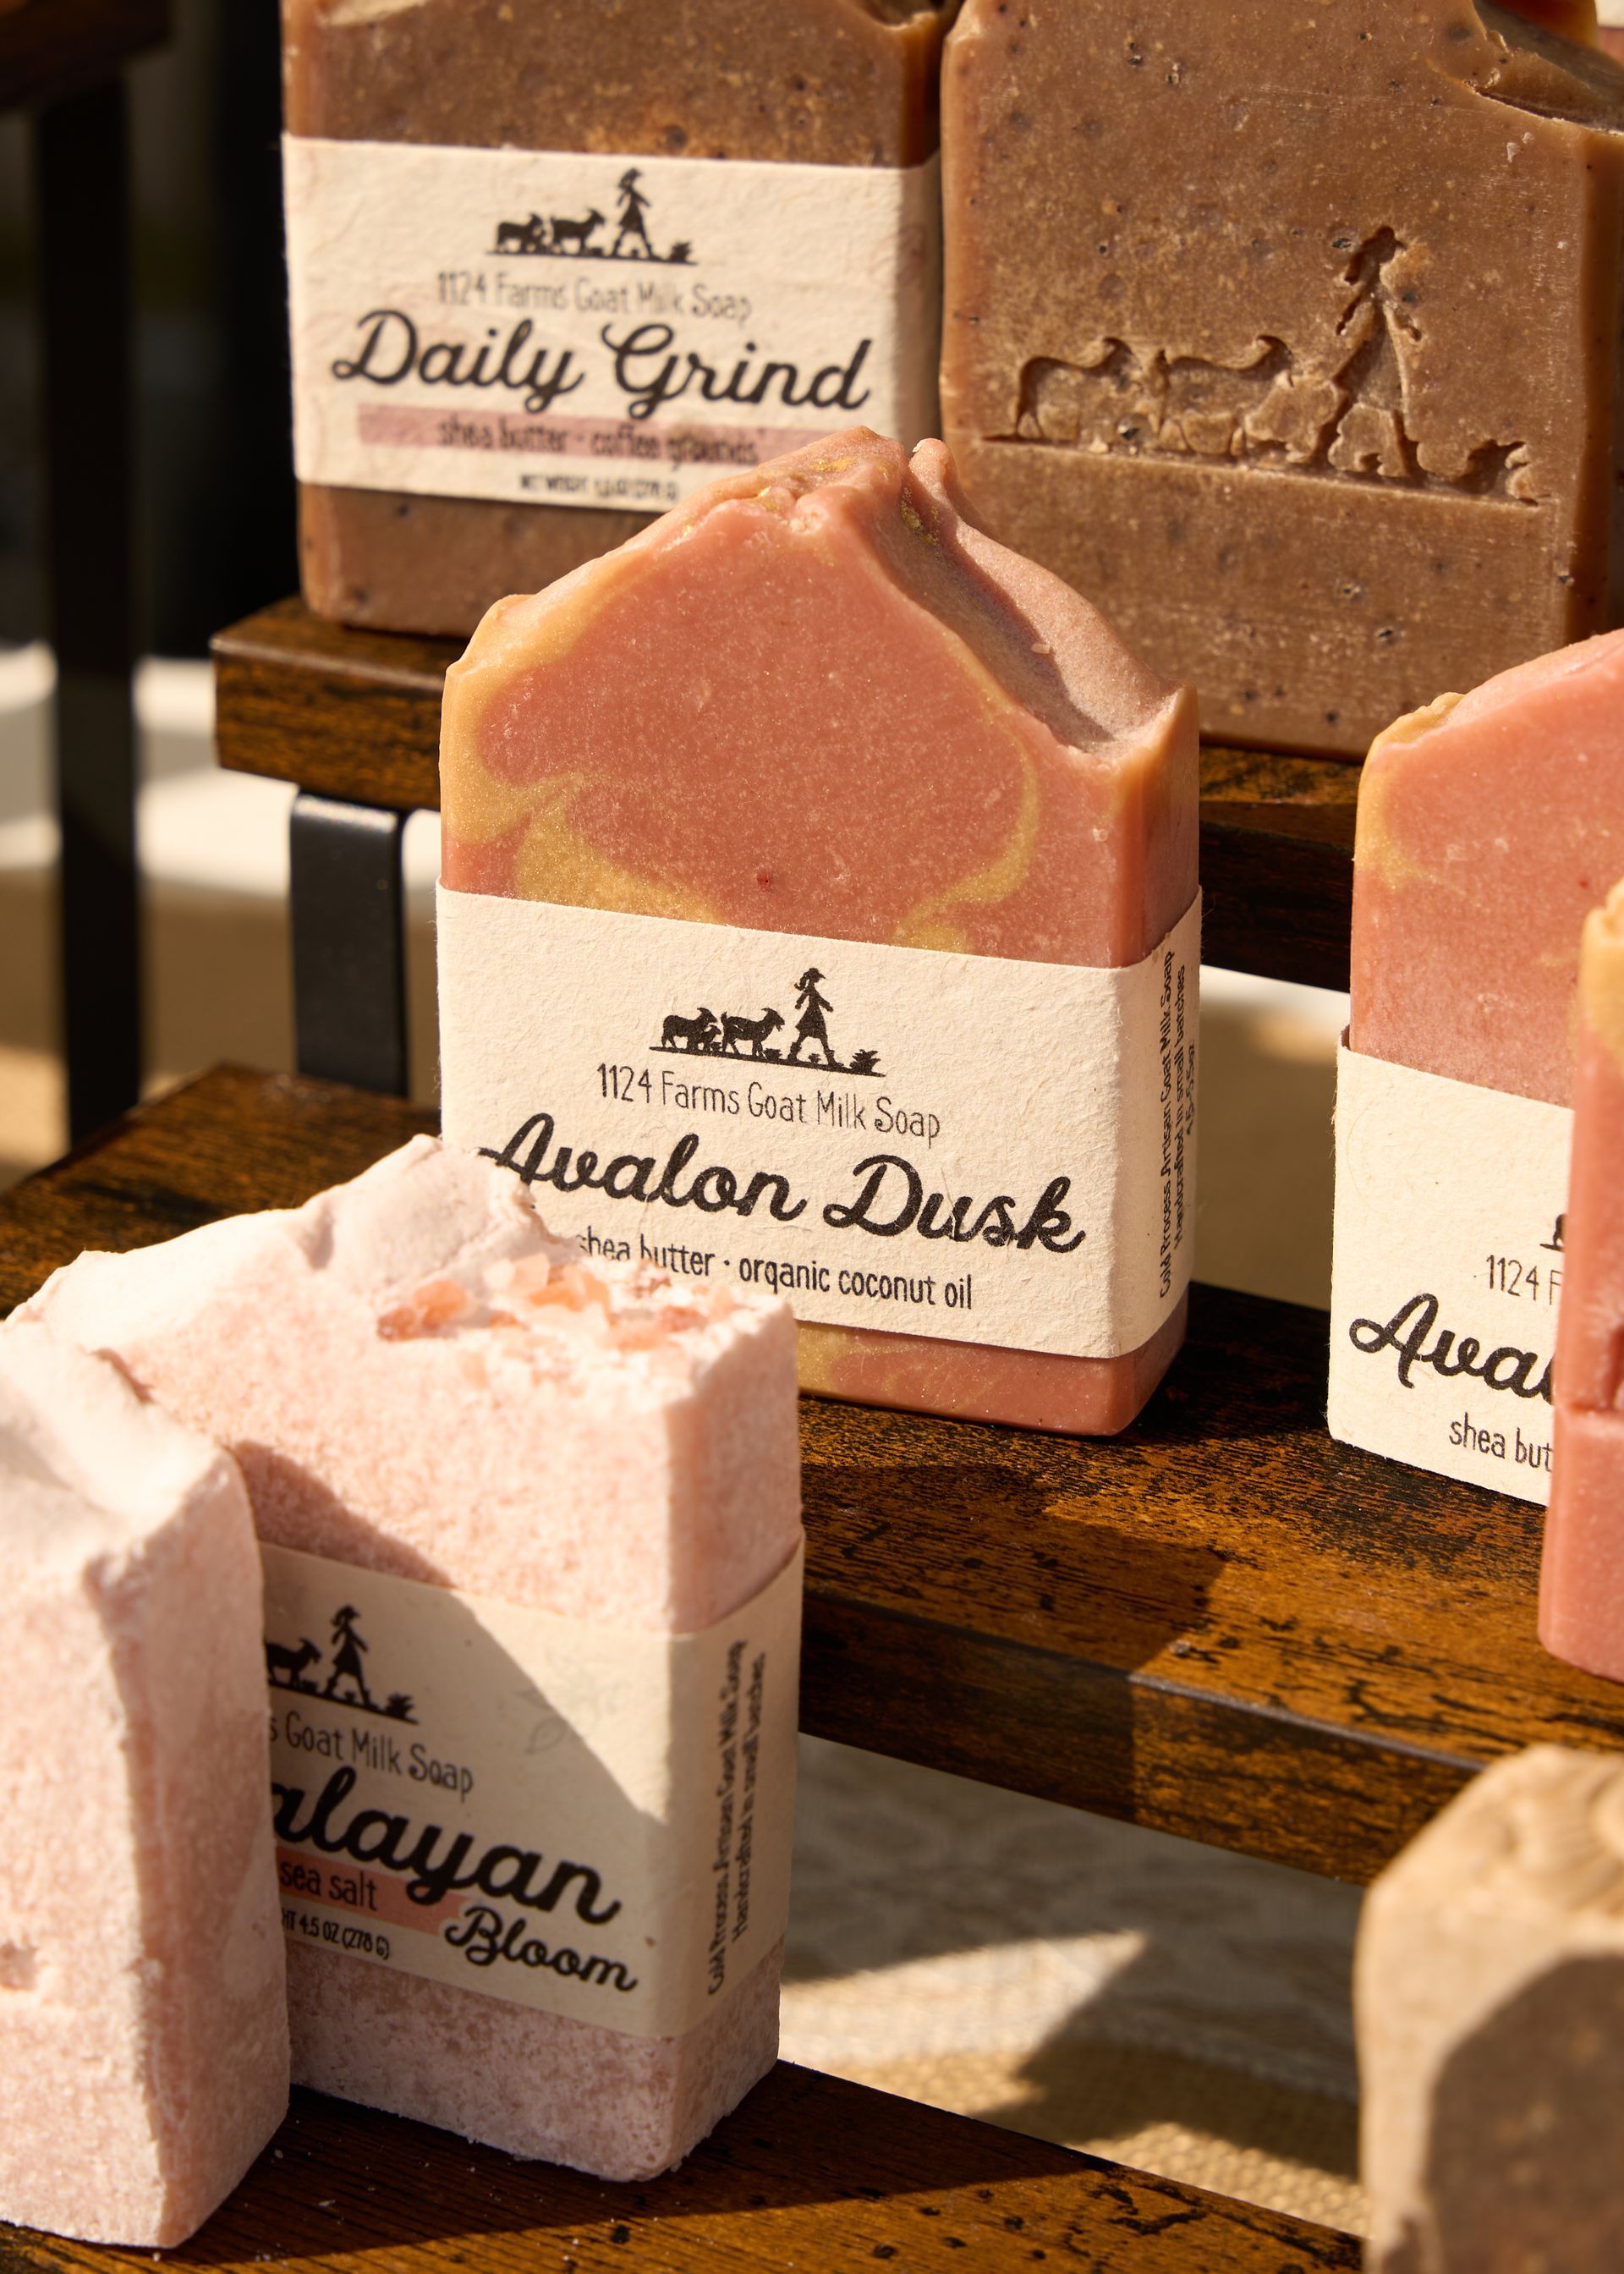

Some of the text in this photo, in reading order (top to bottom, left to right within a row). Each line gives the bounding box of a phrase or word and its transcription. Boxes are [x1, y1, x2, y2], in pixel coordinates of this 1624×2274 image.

[438, 271, 753, 327] 1124 Farms Goat Milk Soap
[332, 310, 873, 420] Daily Grind
[438, 415, 492, 449] shea
[499, 418, 569, 454] butter
[593, 423, 661, 459] coffee
[1174, 964, 1185, 1048] batches
[597, 1063, 940, 1149] 1124 Farms Goat Milk Soap
[1173, 1046, 1184, 1102] small
[1160, 951, 1175, 1299] Cold Process Artisan Goat Milk Soap
[478, 1112, 1087, 1254] Avalon Dusk
[1173, 1128, 1184, 1250] Handcrafted
[739, 1256, 830, 1294] organic
[838, 1269, 935, 1305] coconut
[944, 1273, 972, 1310] oil
[1486, 1254, 1539, 1301] 1124
[1348, 1293, 1554, 1406] Ava
[1449, 1411, 1553, 1473] shea but
[286, 1711, 343, 1761] Goat
[352, 1727, 403, 1776] Milk
[408, 1743, 474, 1804] Soap
[271, 1766, 622, 1925] alayan
[280, 1862, 378, 1912] sea salt
[299, 1913, 320, 1938] 4.5
[322, 1920, 340, 1944] OZ
[342, 1927, 373, 1953] (278
[376, 1935, 391, 1961] G)
[444, 1904, 638, 1993] Bloom
